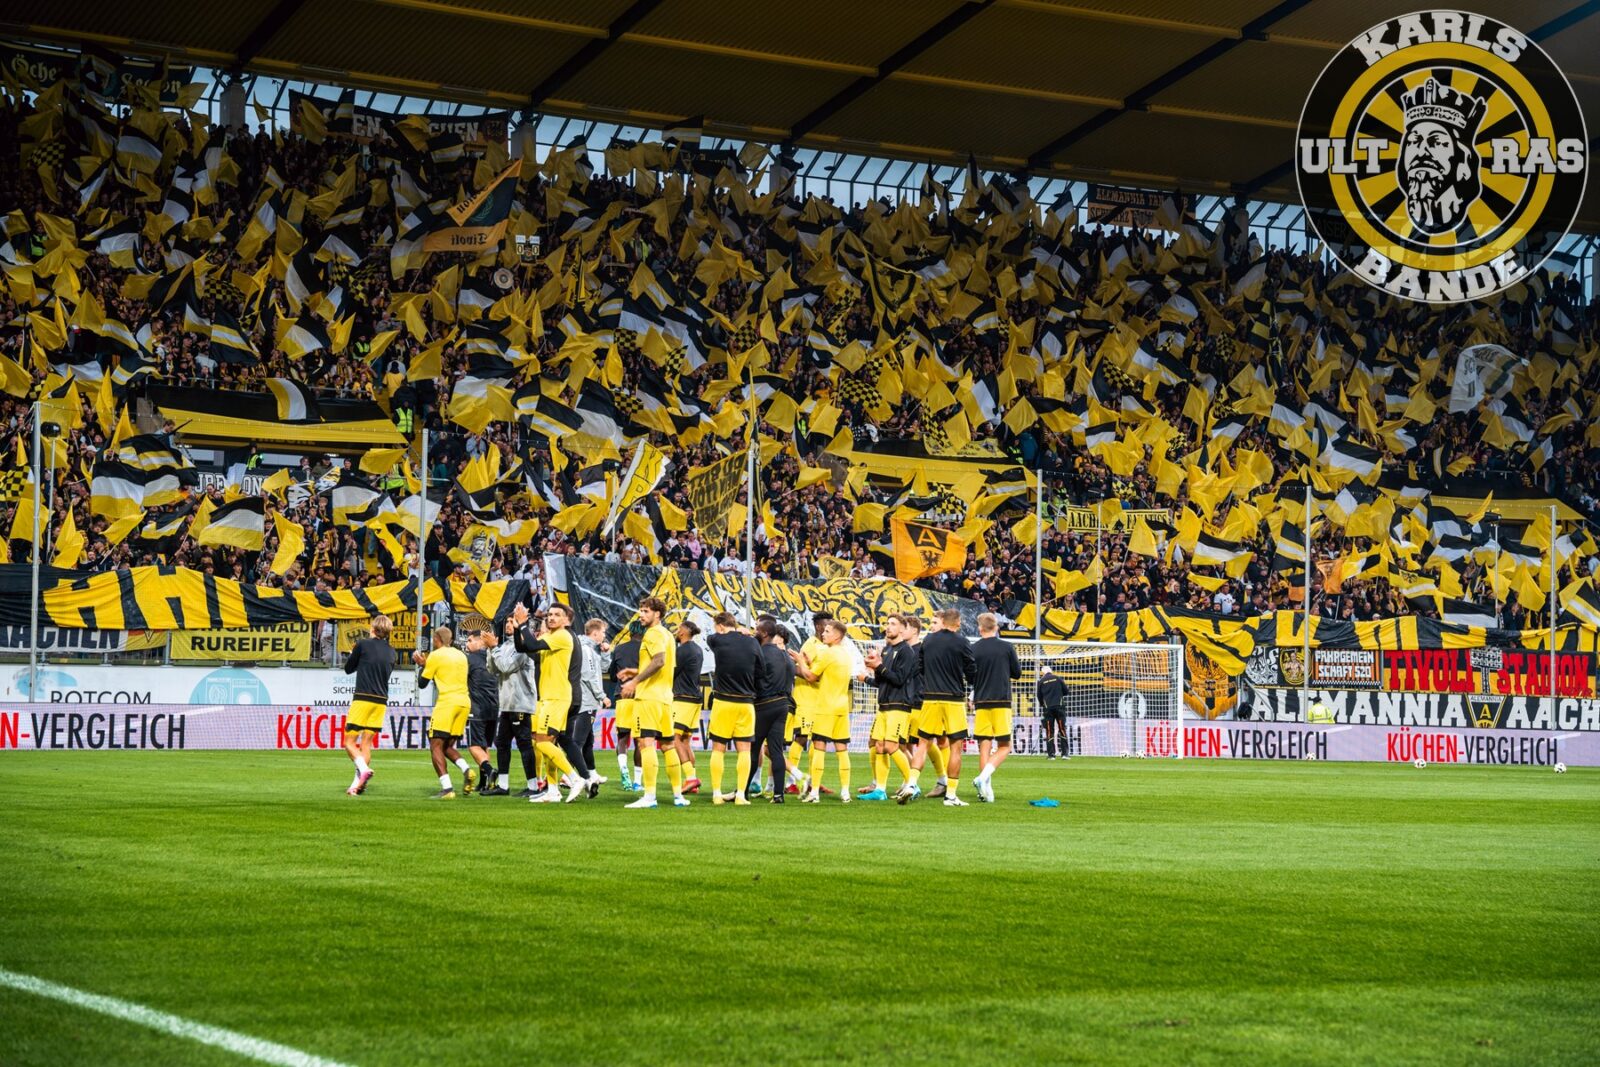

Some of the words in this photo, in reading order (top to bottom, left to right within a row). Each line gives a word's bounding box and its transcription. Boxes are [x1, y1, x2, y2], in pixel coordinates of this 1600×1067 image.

[191, 636, 295, 652] RUREIFEL
[1385, 649, 1475, 694] TIVOLI
[1496, 652, 1589, 697] STADION
[1146, 720, 1327, 760] KÜCHEN-VERGLEICH
[1387, 727, 1558, 766] KÜCHEN-VERGLEICH
